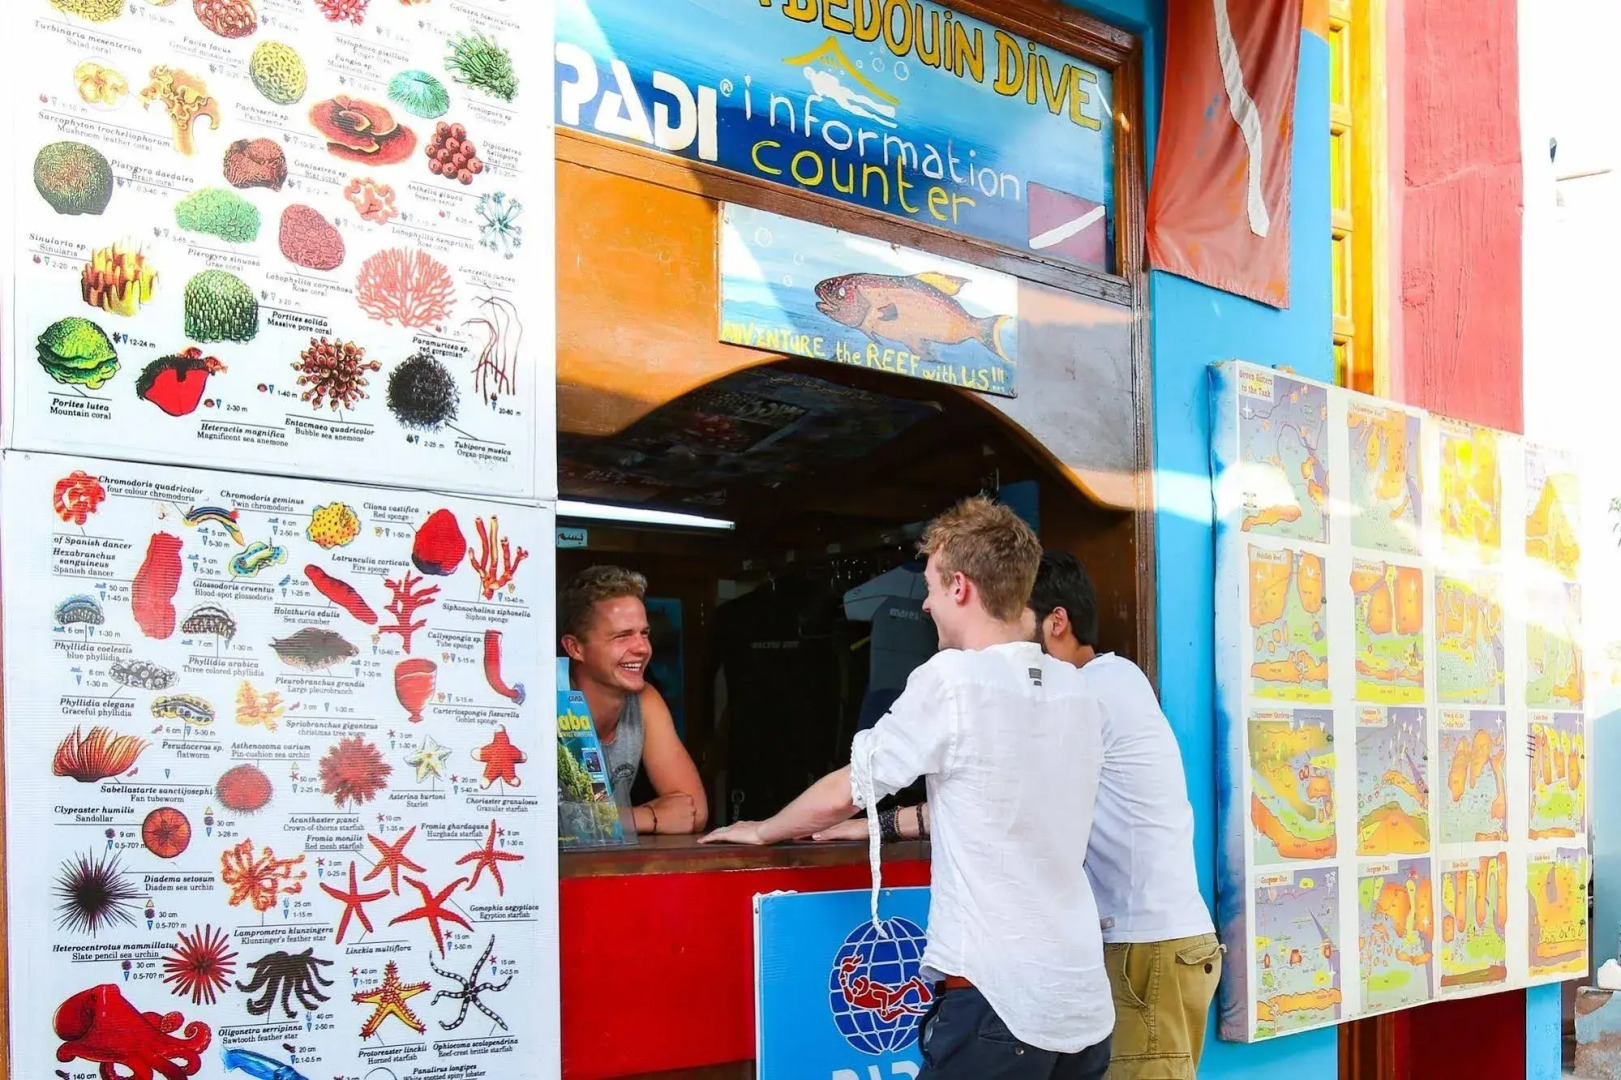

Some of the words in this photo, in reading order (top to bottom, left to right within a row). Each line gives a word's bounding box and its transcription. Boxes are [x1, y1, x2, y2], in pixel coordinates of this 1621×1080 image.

[38, 111, 95, 130] Sarcophyton
[555, 41, 718, 162] PADI
[744, 74, 1020, 201] information
[110, 159, 153, 174] Platygyra
[751, 139, 976, 225] counter
[29, 233, 73, 248] Sinularia
[39, 244, 78, 257] Sinularia
[267, 318, 296, 329] Massive
[298, 324, 313, 333] pore
[304, 318, 328, 327] solida
[129, 338, 147, 348] 12-24
[412, 337, 455, 350] Paramuricea
[419, 345, 431, 354] red
[836, 341, 862, 364] the
[866, 342, 921, 375] REEF
[922, 365, 957, 387] with
[277, 390, 290, 398] 1-40
[52, 398, 84, 409] Porites
[86, 401, 109, 411] lutea
[226, 404, 240, 412] 2-30
[50, 406, 90, 418] Mountain
[91, 411, 111, 420] coral
[201, 423, 243, 433] Heteractis
[245, 428, 285, 439] magnifica
[295, 428, 320, 438] Bubble
[334, 434, 365, 442] anemone
[330, 425, 375, 436] quadricolor
[197, 431, 241, 442] Magnificent
[257, 437, 288, 447] anemone
[99, 474, 153, 489] Chromodoris
[154, 481, 204, 496] quadricolor
[107, 485, 123, 493] four
[125, 488, 148, 496] colour
[149, 490, 195, 502] chromodoris
[220, 490, 271, 501] Chromodoris
[272, 495, 305, 505] geminus
[231, 500, 249, 508] Twin
[251, 502, 294, 512] chromodoris
[373, 511, 386, 519] Red
[387, 512, 410, 521] sponge
[53, 536, 64, 544] of
[65, 537, 100, 548] Spanish
[102, 539, 133, 550] dancer
[53, 547, 116, 561] Hexabranchus
[59, 558, 109, 568] sanguineus
[54, 565, 86, 576] Spanish
[88, 568, 114, 577] dancer
[273, 607, 316, 618] Holothuria
[317, 610, 340, 619] edulis
[298, 618, 330, 626] cucumber
[54, 642, 95, 653] Phyllidia
[97, 645, 133, 654] coelestis
[436, 640, 452, 648] Tube
[453, 642, 474, 650] sponge
[67, 652, 85, 660] blue
[86, 653, 120, 662] phyllidia
[188, 657, 226, 669] Phyllidia
[228, 660, 258, 668] arabica
[182, 665, 204, 674] Three
[205, 667, 232, 675] colored
[233, 668, 265, 678] phyllidia
[275, 677, 335, 688] Pleurobranchus
[336, 678, 365, 688] grandis
[60, 697, 100, 706] Phyllidia
[102, 699, 135, 708] elegans
[62, 707, 96, 715] Graceful
[98, 708, 132, 717] phyllidia
[556, 708, 592, 732] aba
[231, 742, 282, 750] Asthenosoma
[176, 752, 210, 760] flatworm
[231, 750, 273, 758] Pin-cushion
[54, 806, 100, 815] Clypeaster
[102, 806, 135, 814] humilis
[283, 824, 338, 832] Crown-of-thorns
[339, 824, 365, 832] starfish
[143, 875, 181, 883] Diadema
[145, 883, 174, 892] Diadem
[189, 884, 214, 892] urchin
[234, 928, 287, 937] Lamprometra
[288, 927, 333, 935] klunzingera
[241, 936, 286, 945] Klunzinger's
[52, 943, 121, 952] Heterocentrotus
[123, 941, 179, 950] mammillatus
[72, 952, 93, 960] Slate
[95, 952, 118, 960] pencil
[222, 1036, 256, 1045] Sawtooth
[258, 1034, 283, 1042] feather
[368, 1056, 392, 1065] Horned
[413, 1065, 448, 1075] Panulirus
[449, 1064, 477, 1072] longipes
